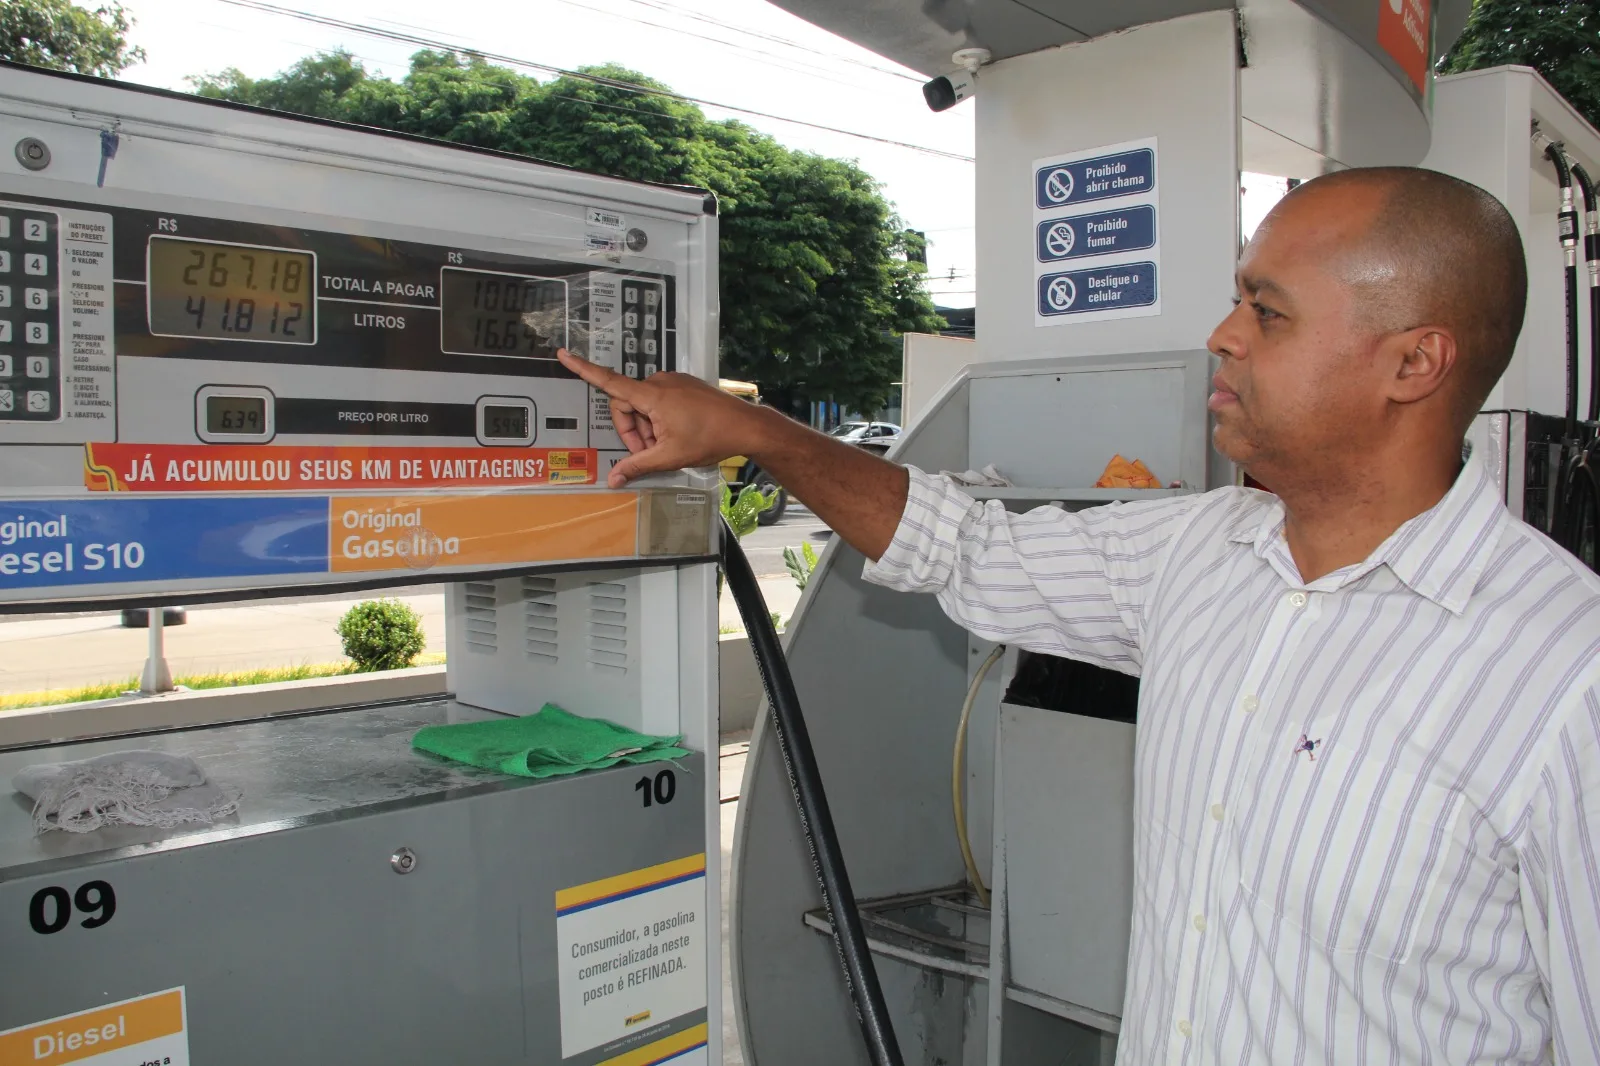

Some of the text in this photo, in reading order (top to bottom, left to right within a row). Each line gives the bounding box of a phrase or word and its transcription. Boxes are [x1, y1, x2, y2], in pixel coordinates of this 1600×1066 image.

[1086, 162, 1127, 179] Proibido
[1086, 174, 1145, 194] abrir chama
[31, 224, 40, 237] 2
[158, 217, 178, 232] R$
[1087, 218, 1128, 234] Proibido
[81, 232, 103, 241] PRESET
[1087, 235, 1116, 248] fumar
[72, 249, 104, 258] SELECIONE
[447, 251, 463, 265] R$
[31, 258, 41, 271] 4
[322, 275, 435, 299] TOTAL A PAGAR
[1088, 274, 1139, 292] Desligue o
[32, 292, 41, 305] 6
[1088, 290, 1122, 303] celular
[354, 313, 406, 330] LITROS
[32, 326, 41, 339] 8
[33, 361, 42, 374] 0
[338, 411, 429, 424] PREÇO POR LITRO
[124, 453, 545, 483] JÁ ACUMULOU SEUS KM DE VANTAGENS?
[342, 507, 422, 533] Original
[342, 533, 460, 560] Gasolina
[83, 541, 145, 571] S10
[635, 769, 676, 808] 10
[29, 880, 117, 935] 09
[571, 911, 695, 959] Consumidor, a gasolina
[578, 934, 690, 981] comercializada neste
[583, 956, 687, 1006] posto é REFINADA.
[33, 1015, 126, 1061] Diesel
[163, 1057, 171, 1065] a
